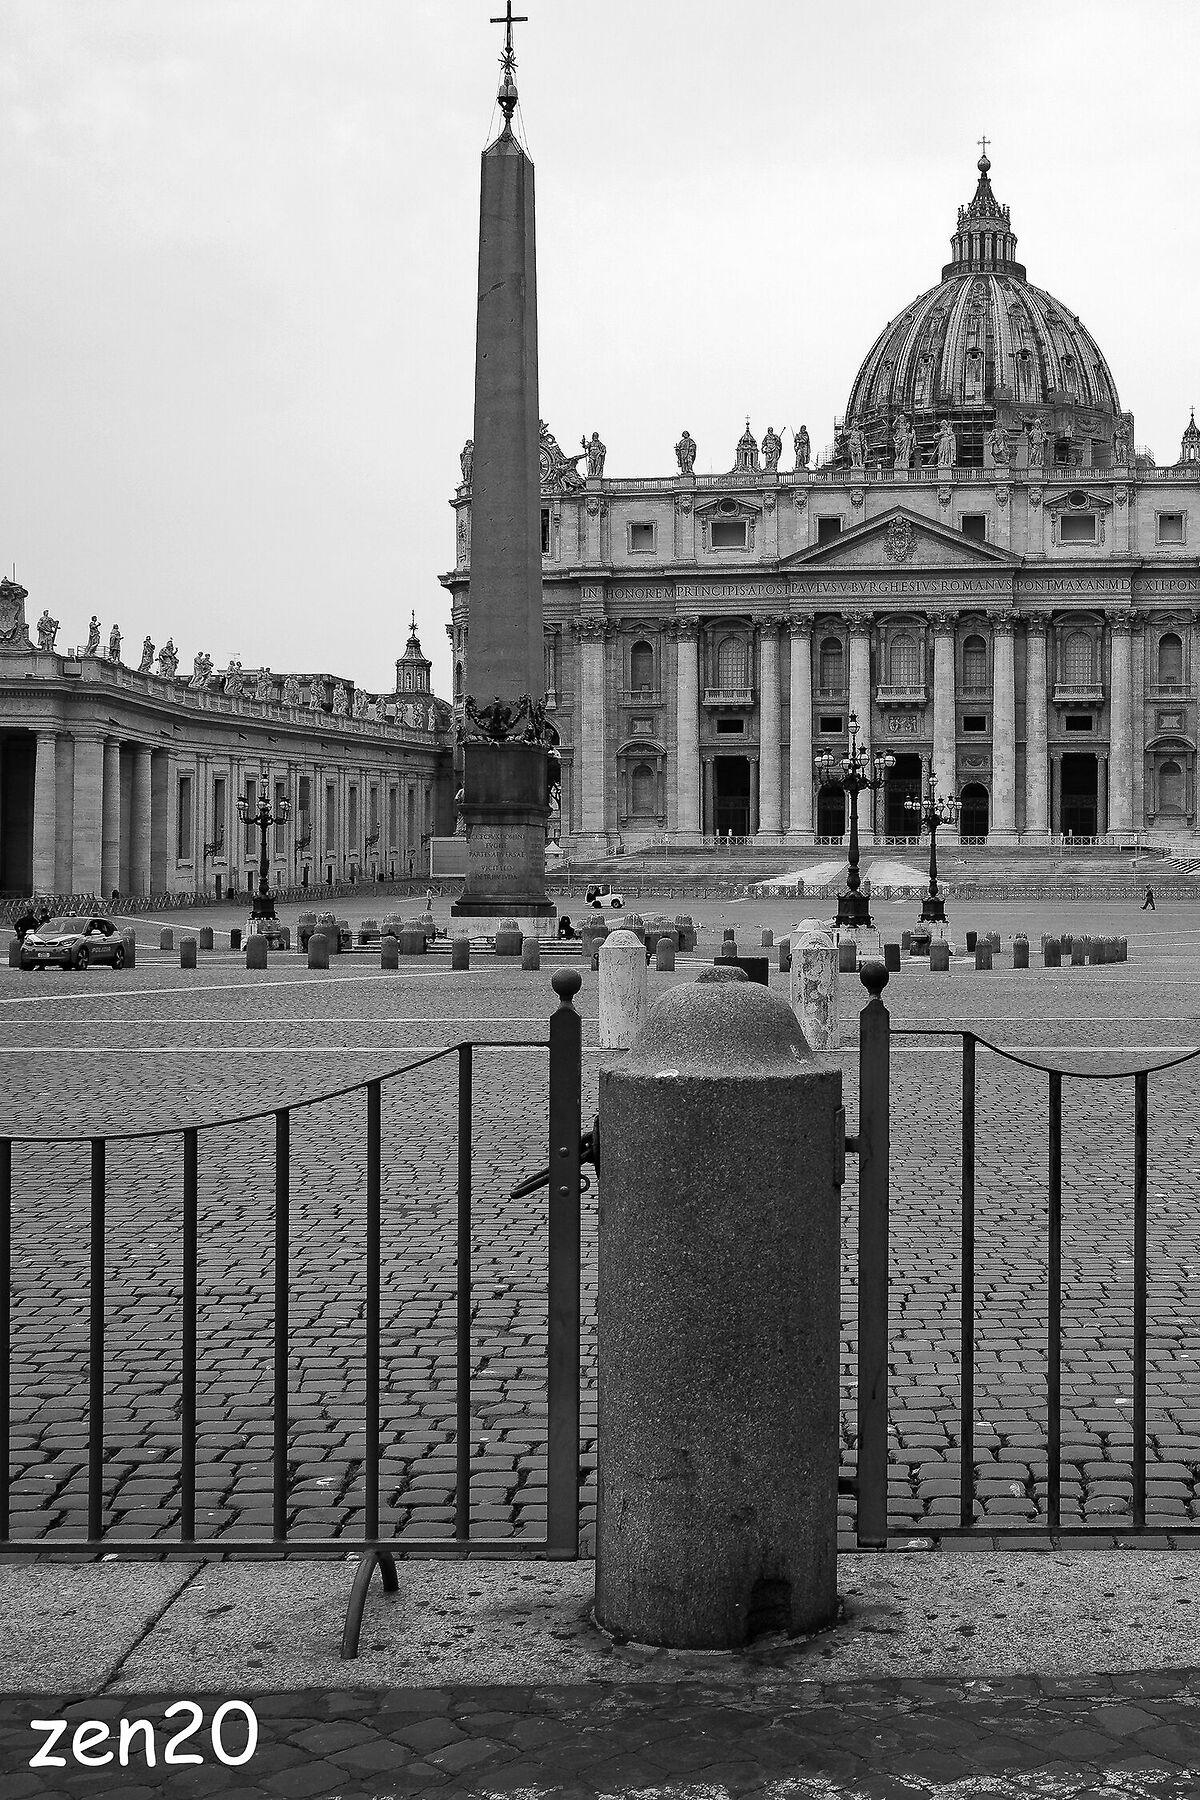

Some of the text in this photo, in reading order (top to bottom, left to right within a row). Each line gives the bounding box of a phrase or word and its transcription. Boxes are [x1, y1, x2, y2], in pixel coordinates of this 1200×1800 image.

[581, 586, 599, 598] IN
[606, 587, 675, 599] HONOREM
[677, 585, 747, 598] PRINCIPIS
[749, 583, 790, 596] APOST
[790, 582, 837, 595] PAVLVS
[850, 580, 938, 594] BVRGHESIVS
[941, 579, 1012, 592] ROMANVS
